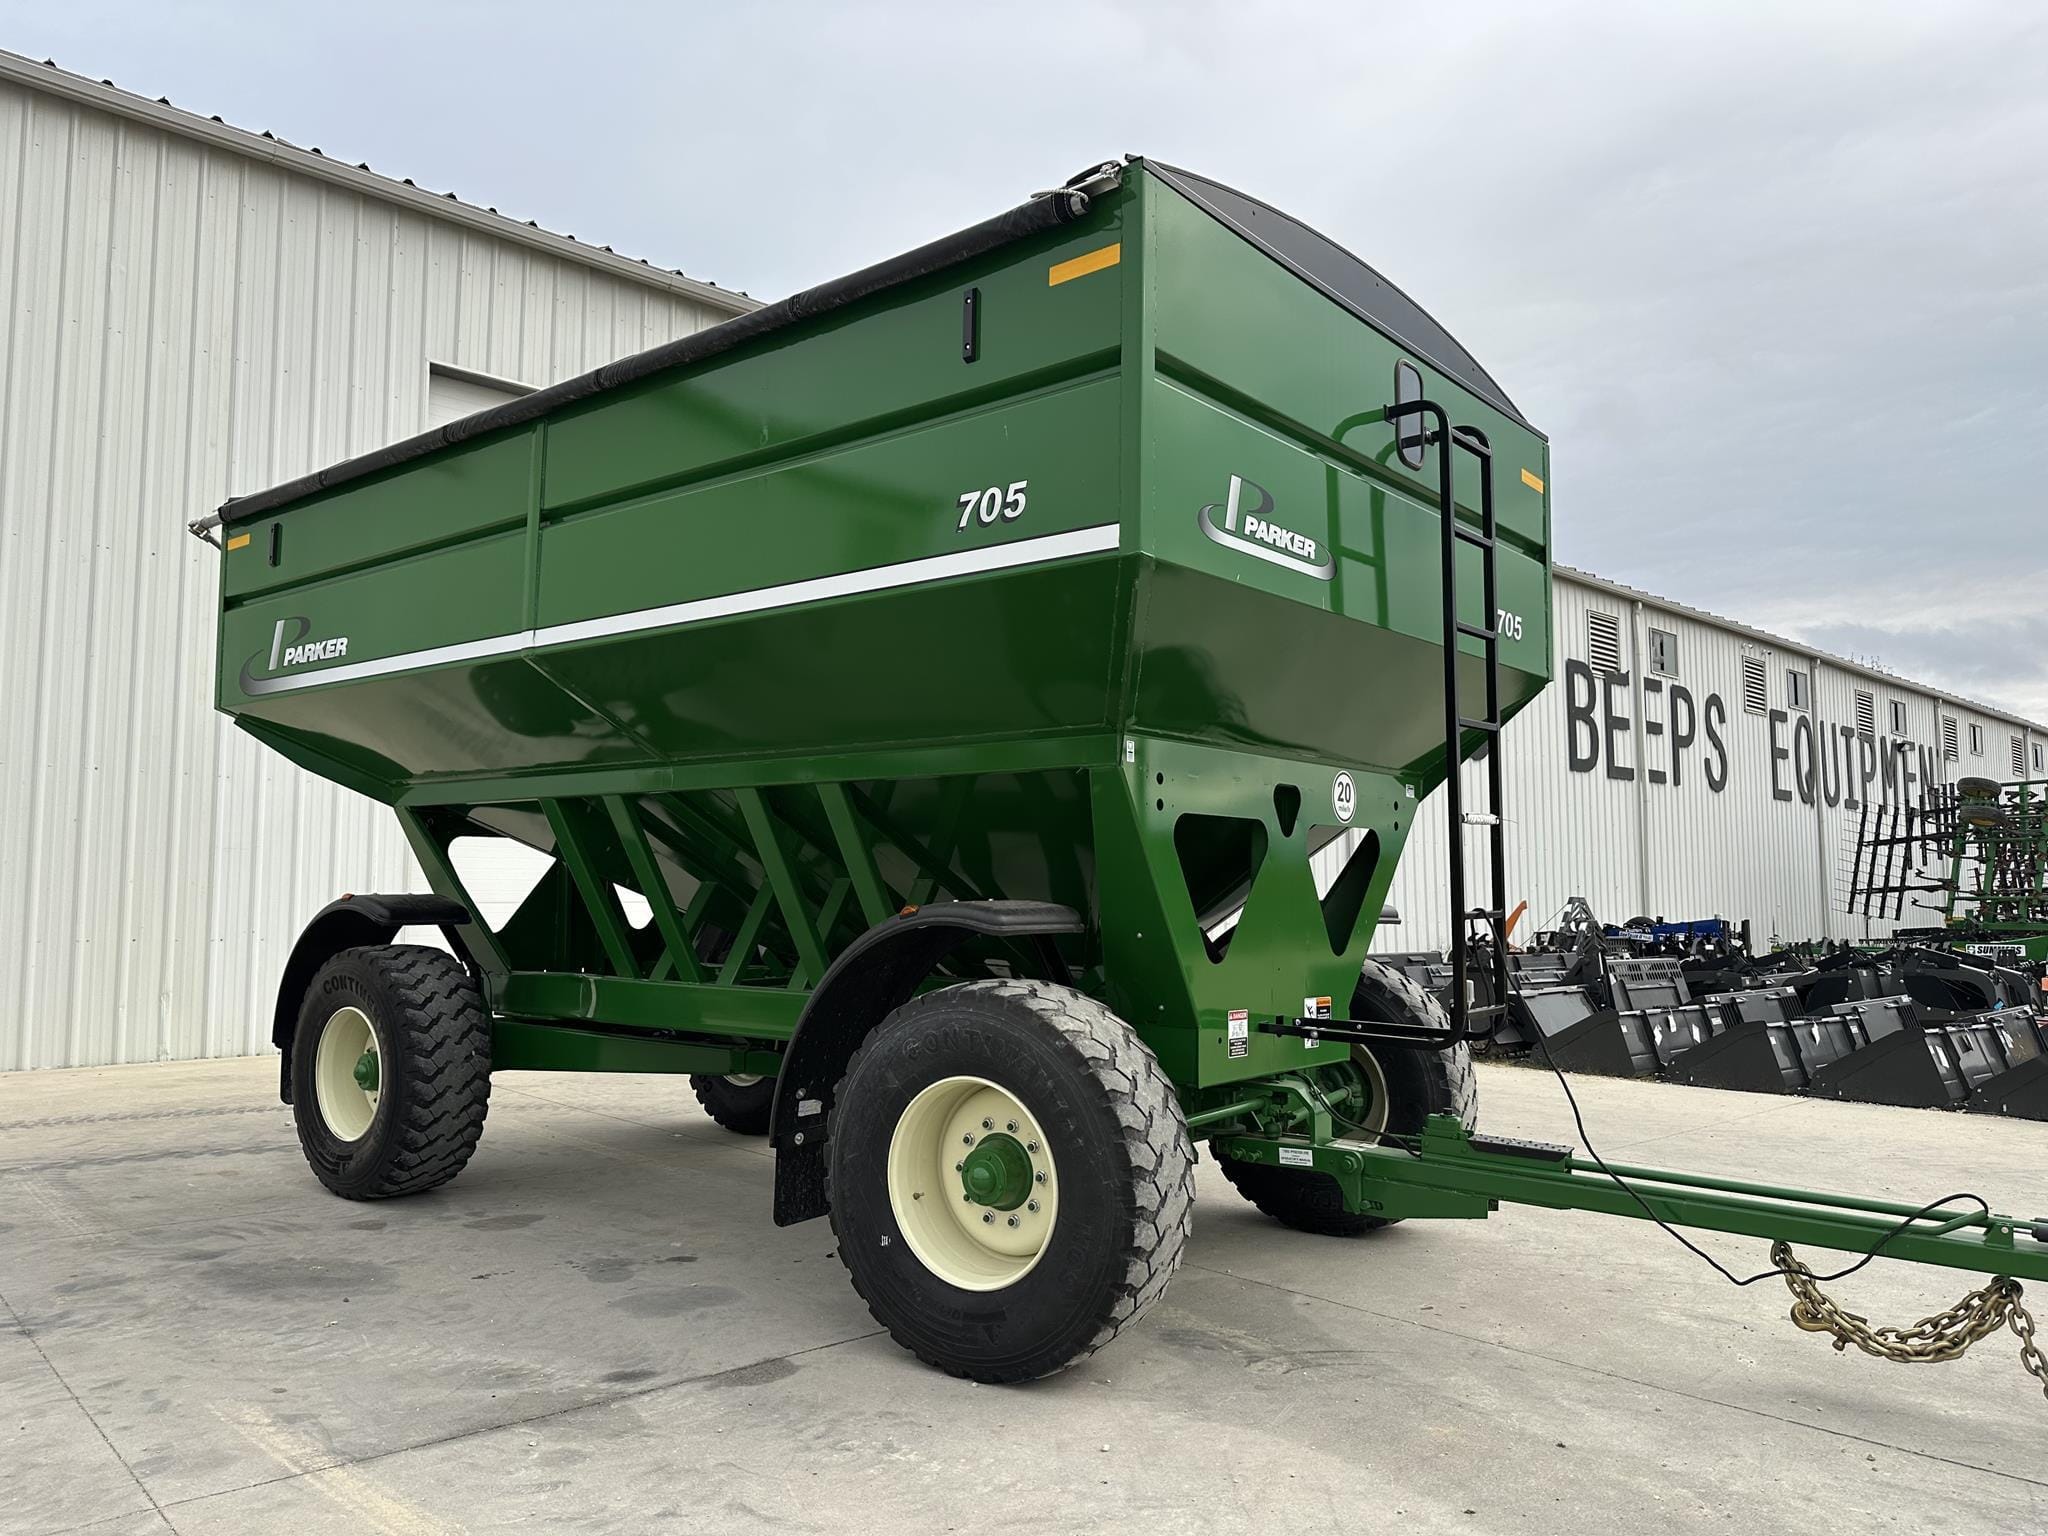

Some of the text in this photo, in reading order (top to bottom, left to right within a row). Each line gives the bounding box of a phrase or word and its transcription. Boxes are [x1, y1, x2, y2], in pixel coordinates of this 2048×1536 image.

[957, 480, 1028, 531] 705
[1244, 514, 1316, 560] PARKER
[1497, 608, 1522, 641] 705
[283, 637, 348, 667] PARKER
[1566, 657, 1728, 793] BEEPS
[1337, 781, 1351, 803] 20
